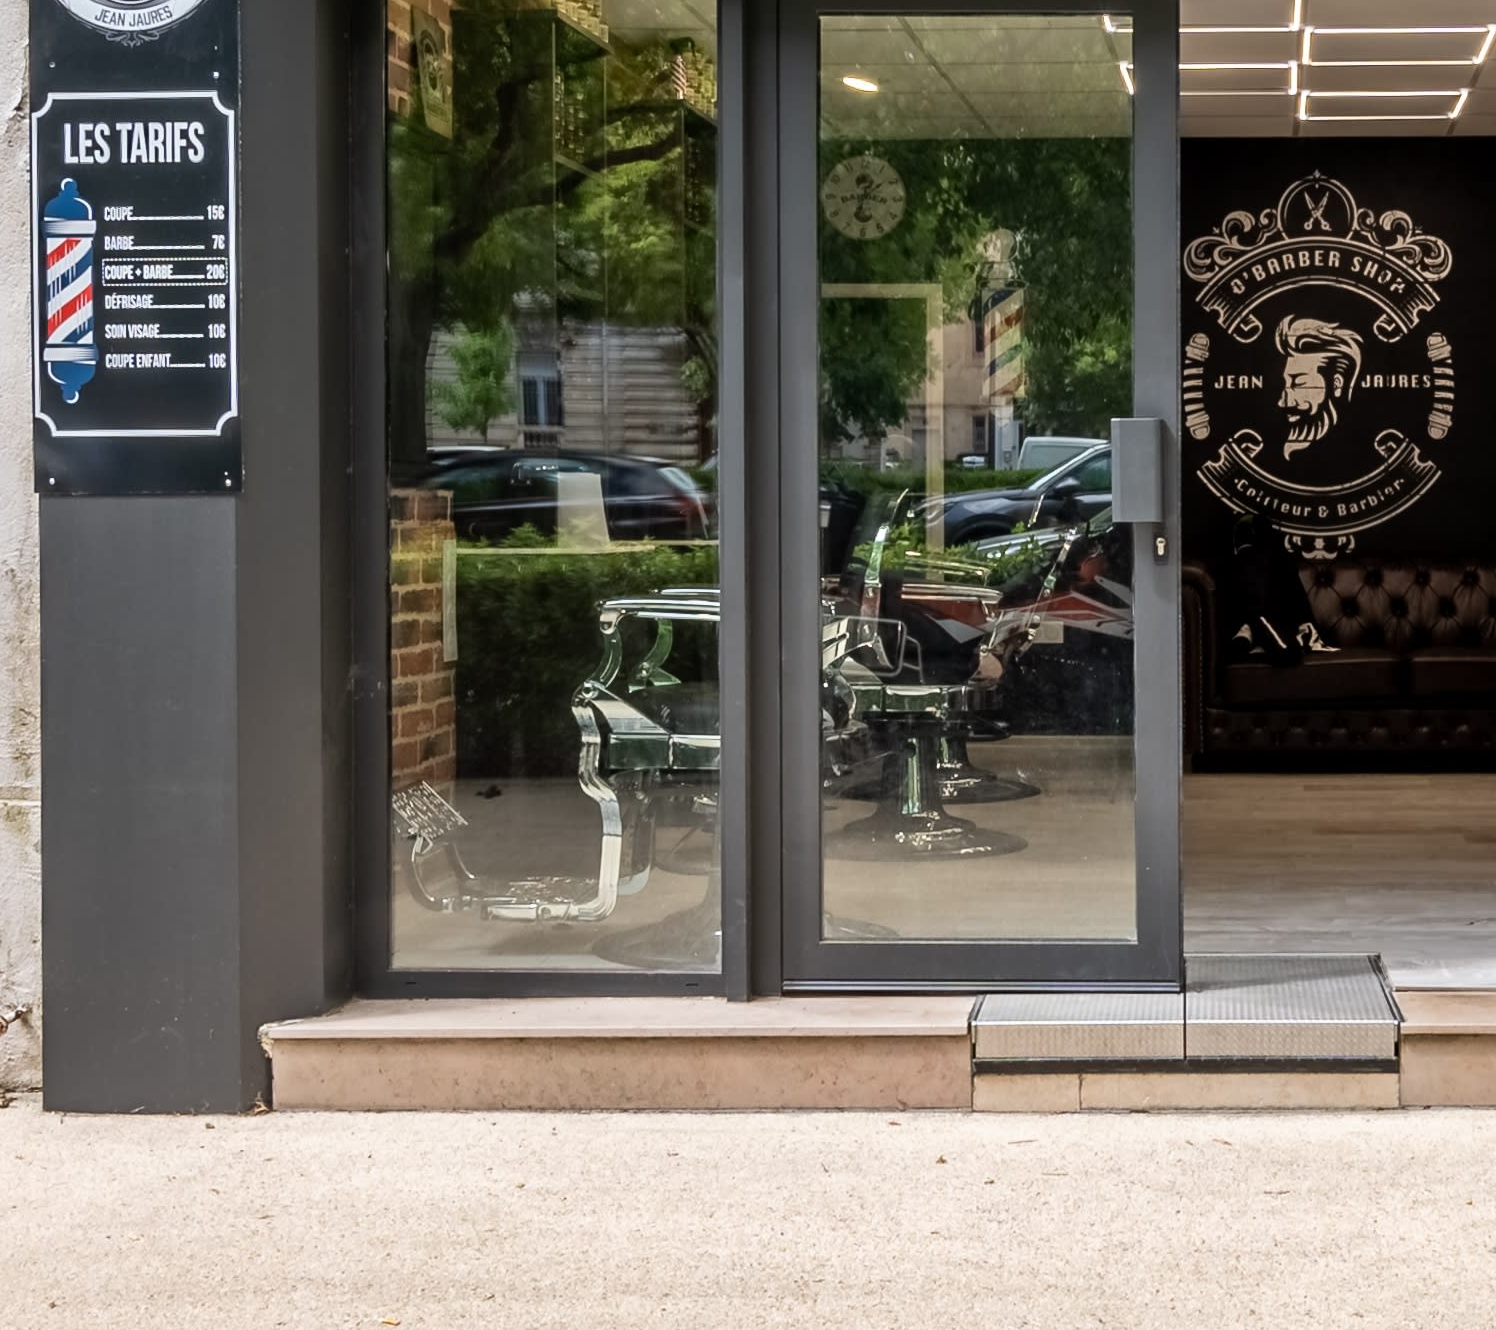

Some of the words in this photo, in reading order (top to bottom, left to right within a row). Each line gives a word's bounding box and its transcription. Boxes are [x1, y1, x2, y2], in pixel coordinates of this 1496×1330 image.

[94, 7, 127, 27] JEAN
[128, 5, 173, 27] JAURES
[63, 122, 111, 165] LES
[116, 121, 205, 164] TARIFS
[104, 206, 134, 221] COUPE
[104, 236, 134, 250] BARBE
[104, 265, 134, 280] COUPE
[143, 265, 173, 280] BARBE
[1229, 249, 1341, 295] O'BARBER
[105, 292, 154, 309] DÉFRISAGE
[105, 324, 127, 339] SOIN
[128, 324, 160, 339] VISAGE
[105, 353, 135, 368] COUPE
[136, 353, 172, 368] ENFANT
[1213, 374, 1263, 391] JEAN
[1360, 373, 1432, 390] JAURES
